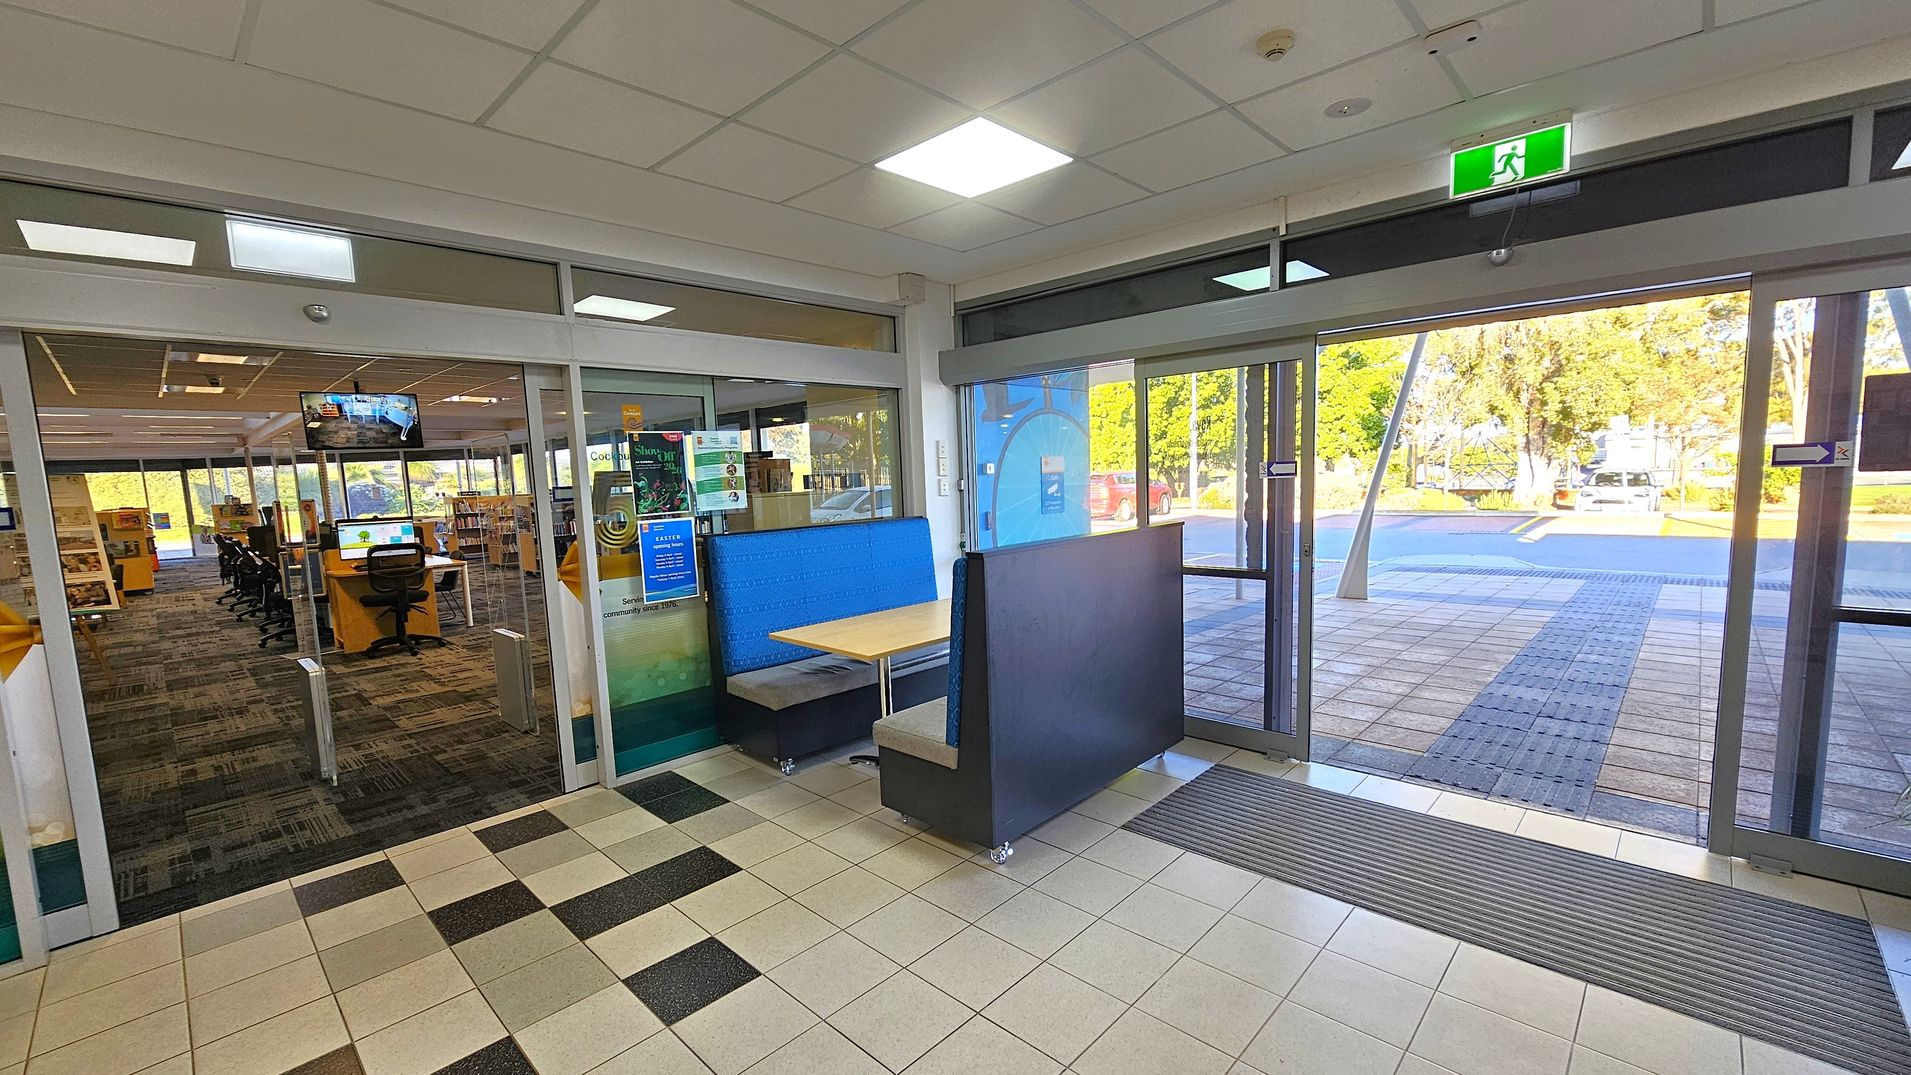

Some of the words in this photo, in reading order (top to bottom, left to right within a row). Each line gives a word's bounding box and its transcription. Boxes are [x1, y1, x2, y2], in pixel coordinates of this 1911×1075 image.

[590, 451, 630, 461] Cockbu
[622, 596, 644, 605] Servin
[603, 608, 641, 618] community
[642, 605, 659, 613] since
[661, 601, 678, 609] 1976.
